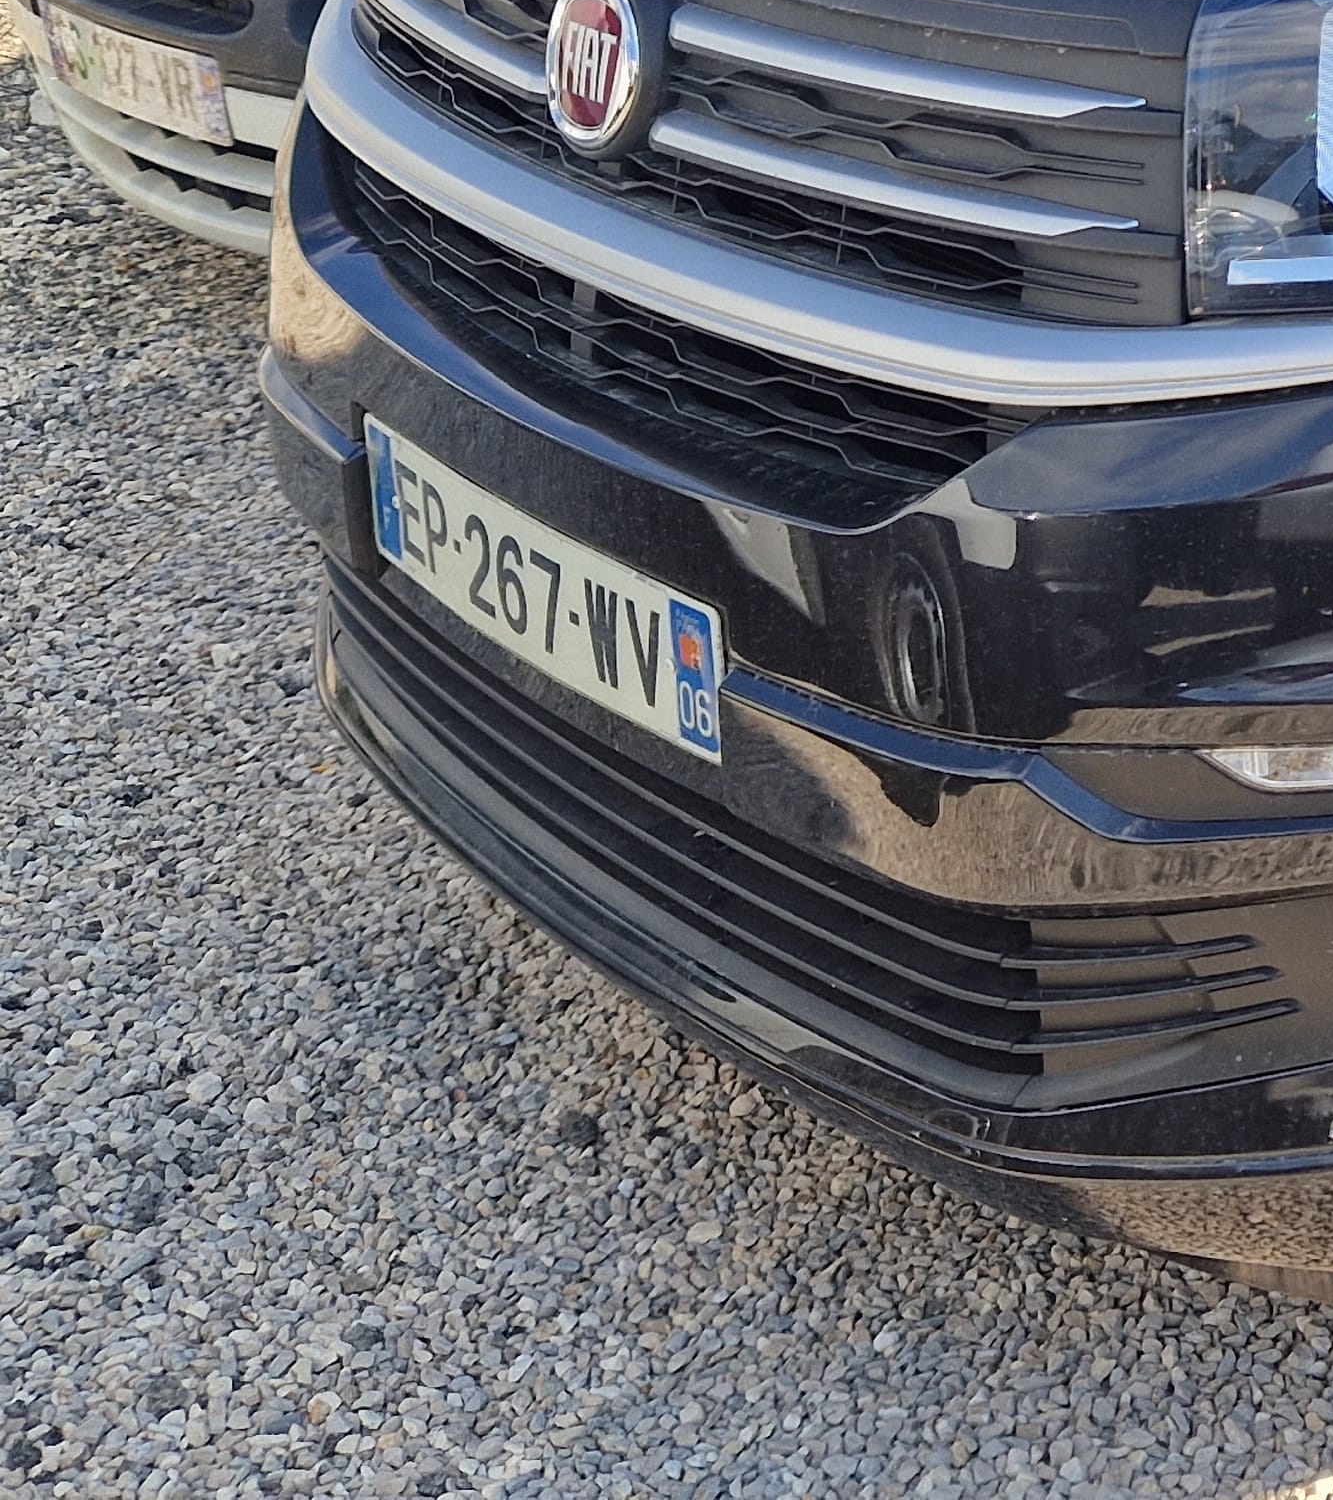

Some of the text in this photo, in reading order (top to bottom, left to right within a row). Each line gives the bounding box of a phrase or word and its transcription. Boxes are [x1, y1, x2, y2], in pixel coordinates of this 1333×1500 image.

[561, 21, 618, 105] FIAT
[395, 459, 660, 708] EP-267-WV
[679, 680, 714, 738] 06
